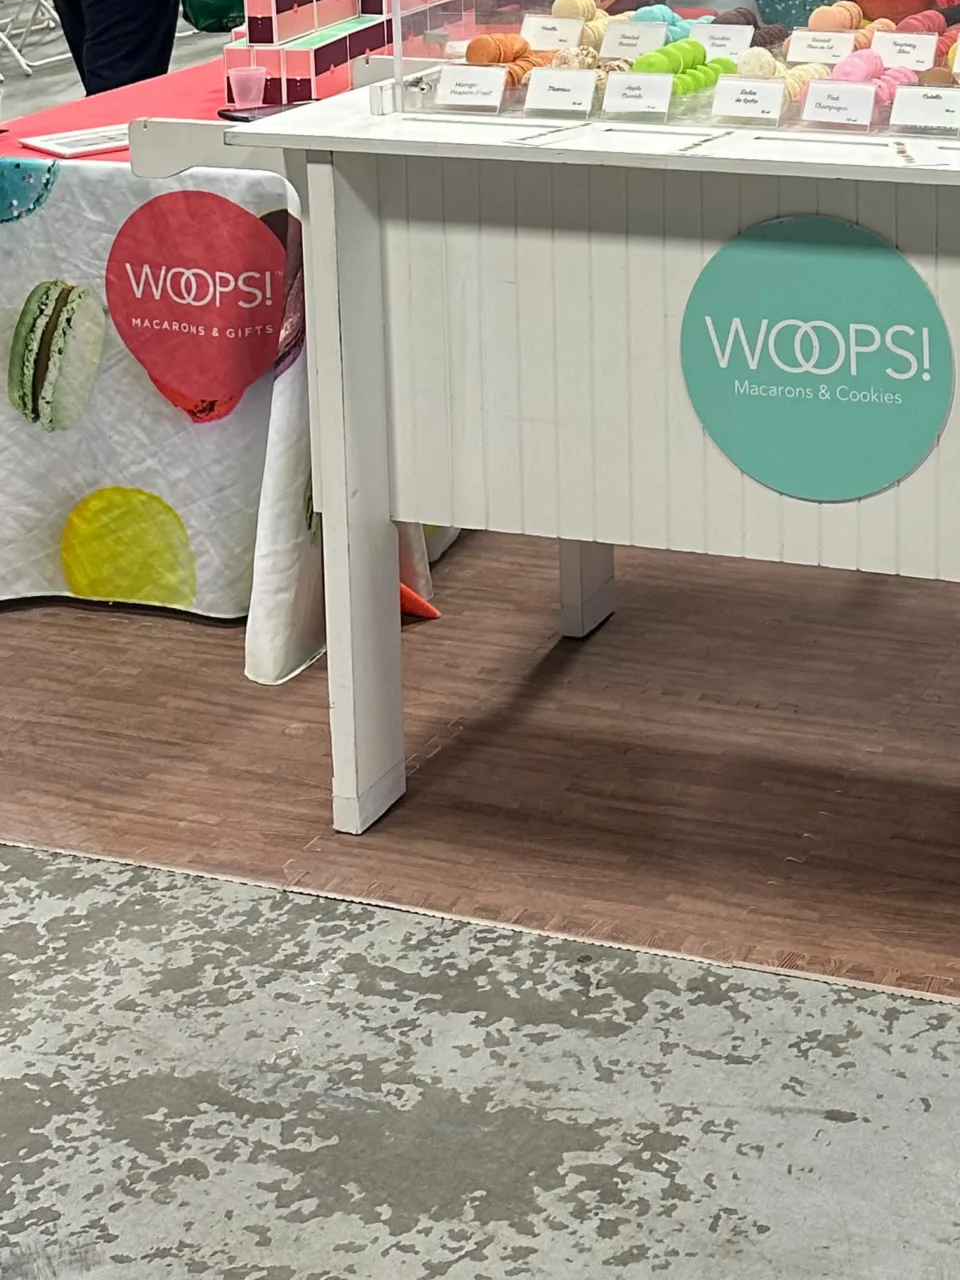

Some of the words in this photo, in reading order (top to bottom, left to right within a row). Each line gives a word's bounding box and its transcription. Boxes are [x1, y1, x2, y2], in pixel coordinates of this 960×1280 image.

[125, 263, 273, 309] WOOPS!
[131, 318, 205, 336] MACARONS
[211, 327, 220, 337] &
[226, 324, 274, 339] GIFTS
[704, 315, 932, 381] WOOPS!
[734, 379, 814, 400] Macarons
[818, 384, 831, 400] &
[836, 384, 903, 405] Cookies
